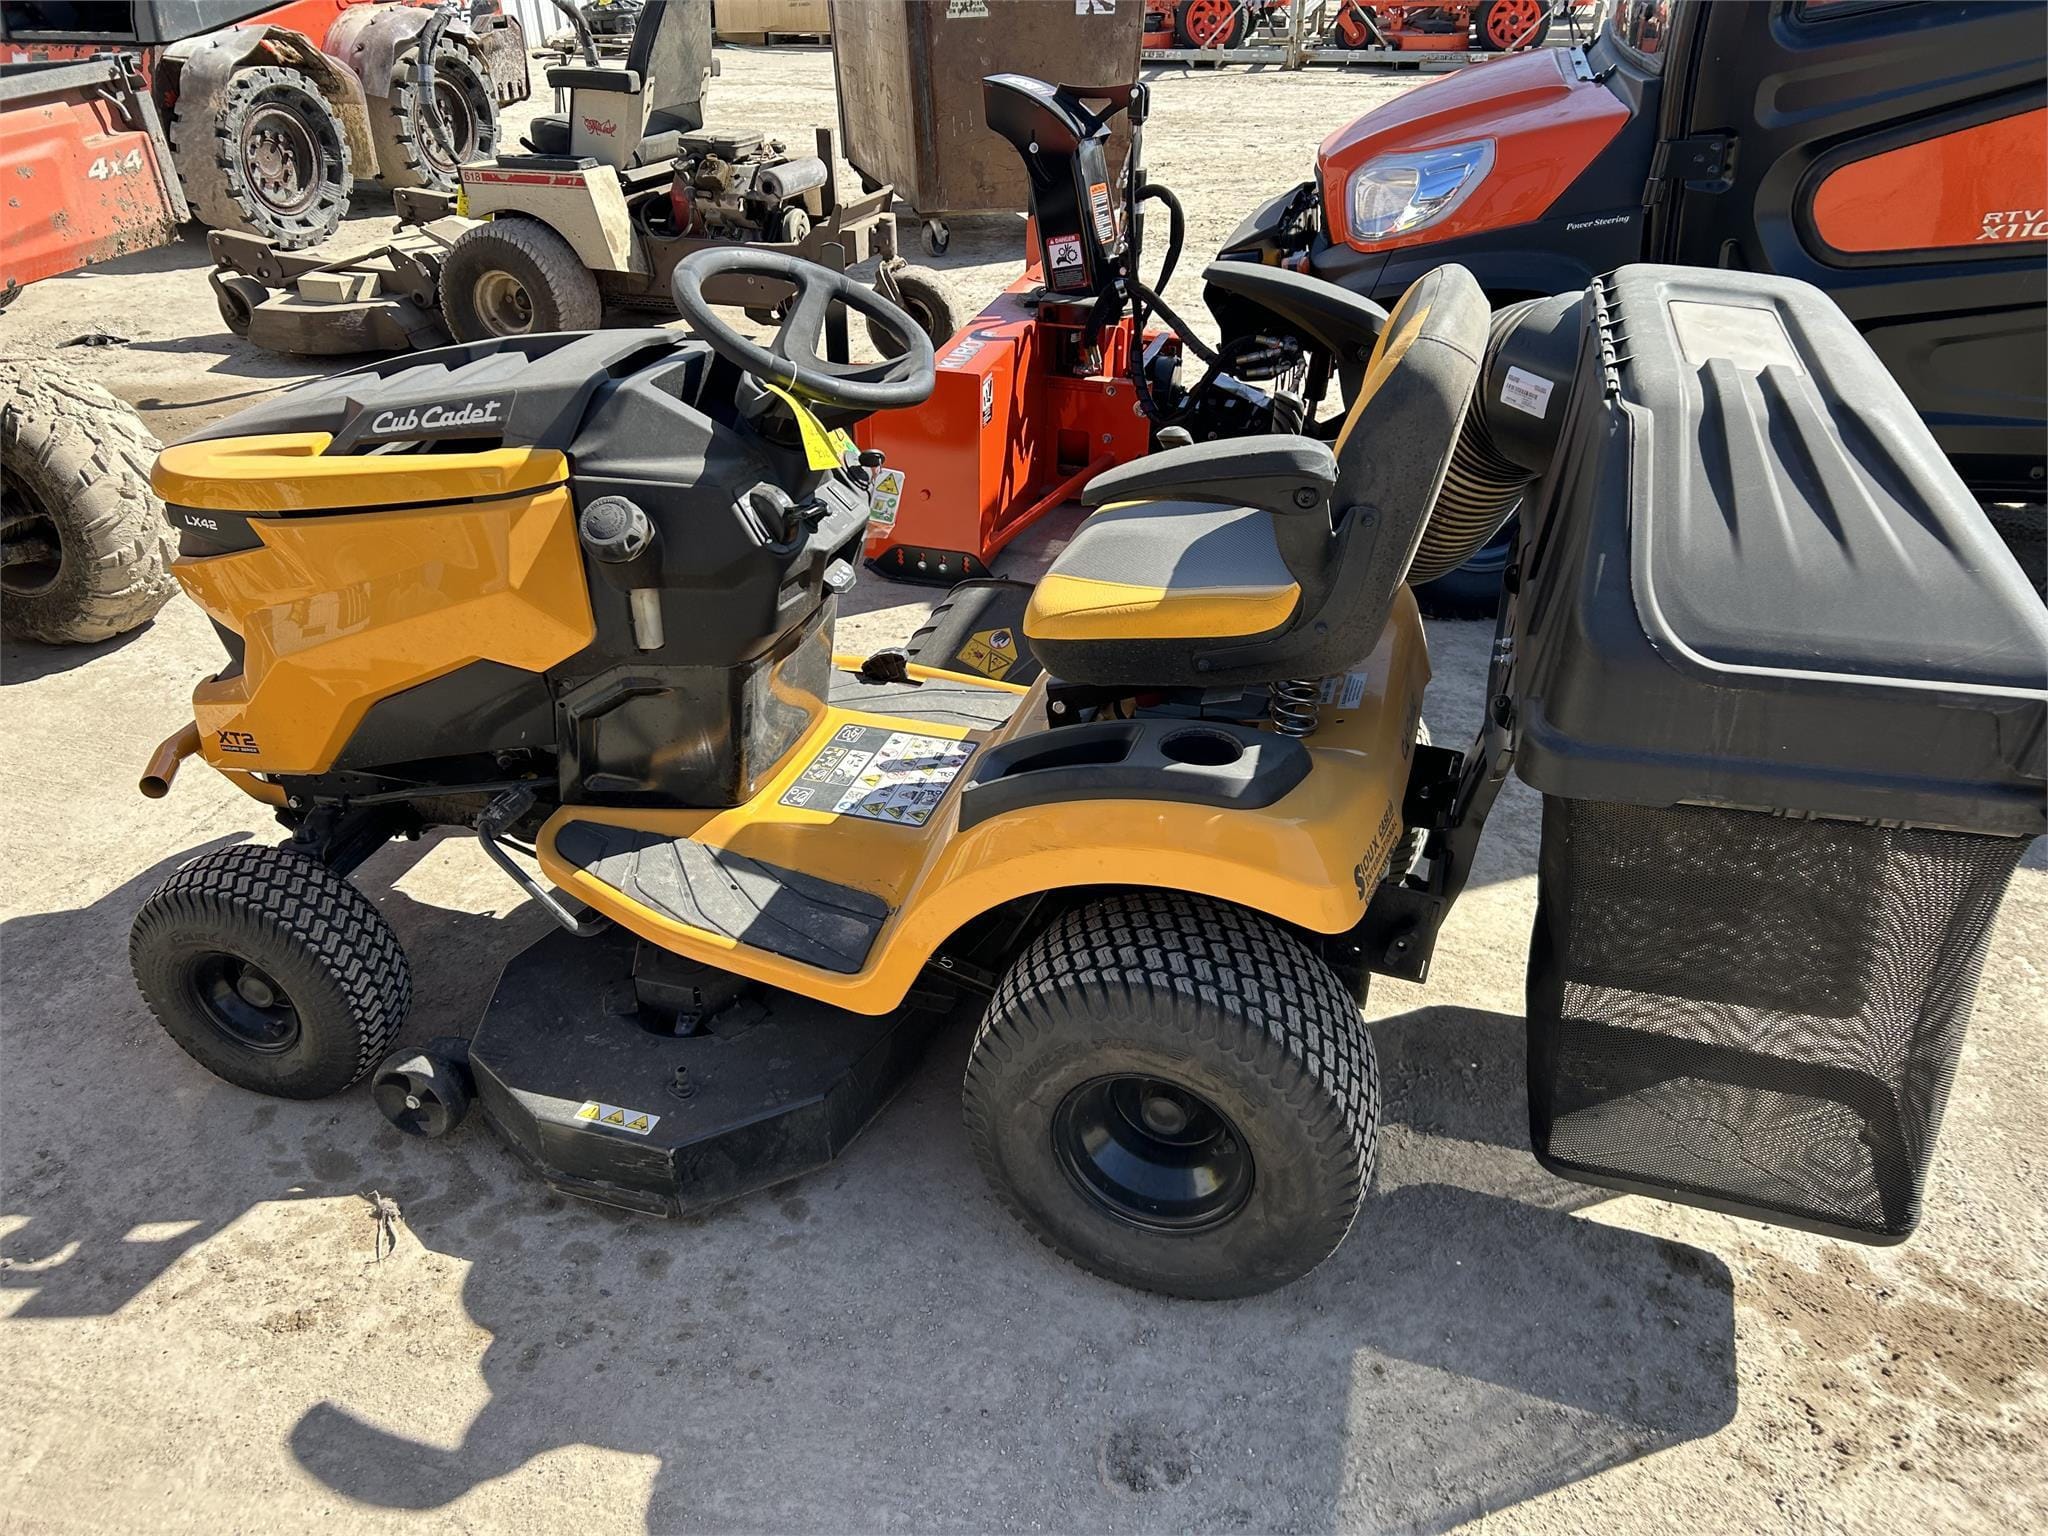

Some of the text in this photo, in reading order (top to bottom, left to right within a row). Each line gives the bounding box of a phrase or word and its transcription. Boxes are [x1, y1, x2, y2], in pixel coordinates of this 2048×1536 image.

[88, 148, 143, 180] 4x4
[464, 171, 481, 182] 618
[1566, 215, 1630, 231] Power Steering
[1982, 209, 2045, 224] RTV
[1054, 235, 1076, 244] DANGER
[372, 400, 501, 433] Cub Cadet
[184, 514, 218, 530] LX42
[216, 730, 257, 746] XT2
[1354, 834, 1380, 900] SIOUX
